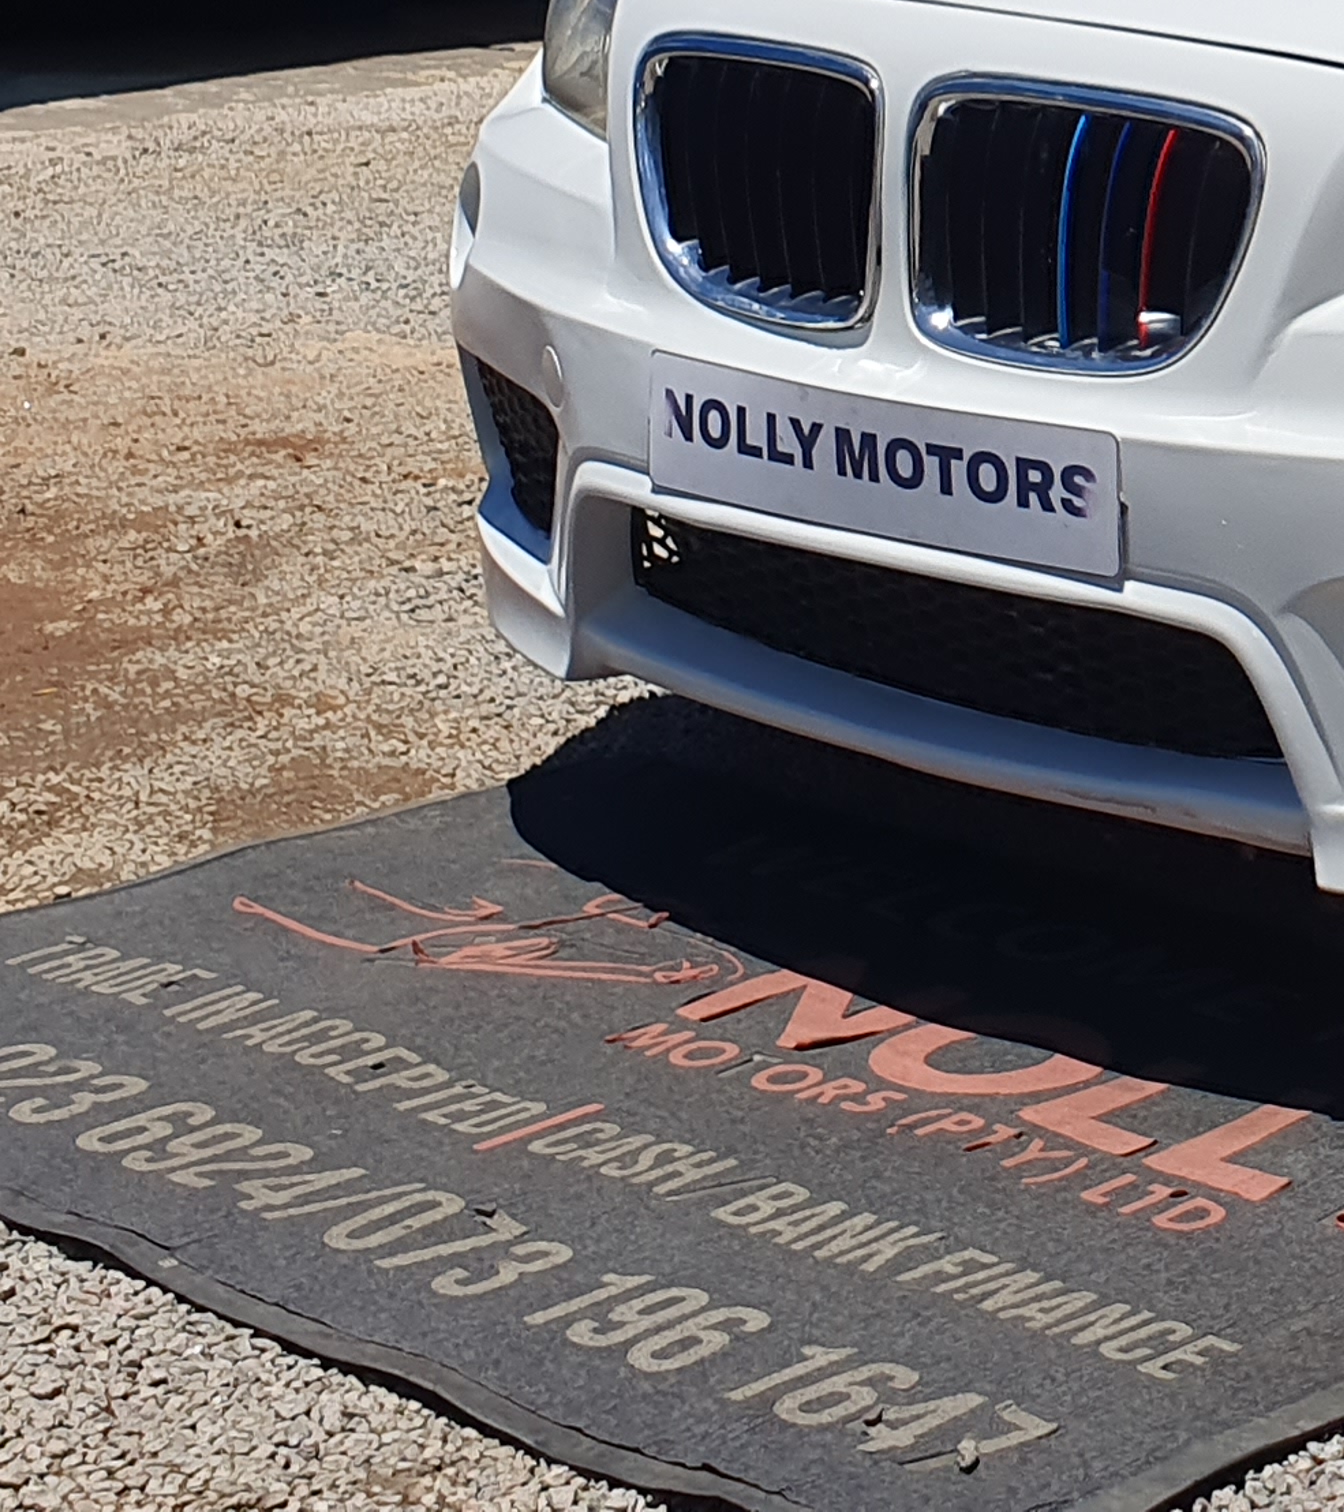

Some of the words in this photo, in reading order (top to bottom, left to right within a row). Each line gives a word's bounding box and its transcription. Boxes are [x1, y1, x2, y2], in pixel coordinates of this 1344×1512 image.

[664, 388, 823, 470] NOLLY
[834, 426, 1097, 518] MOTORS
[5, 934, 219, 1006] TRADE
[161, 984, 281, 1031] IN
[894, 1246, 1244, 1380] FINANCE
[604, 1022, 908, 1112] MOTORS
[1080, 1172, 1228, 1232] LTD
[523, 1272, 771, 1375] 196
[723, 1344, 1061, 1472] 1647
